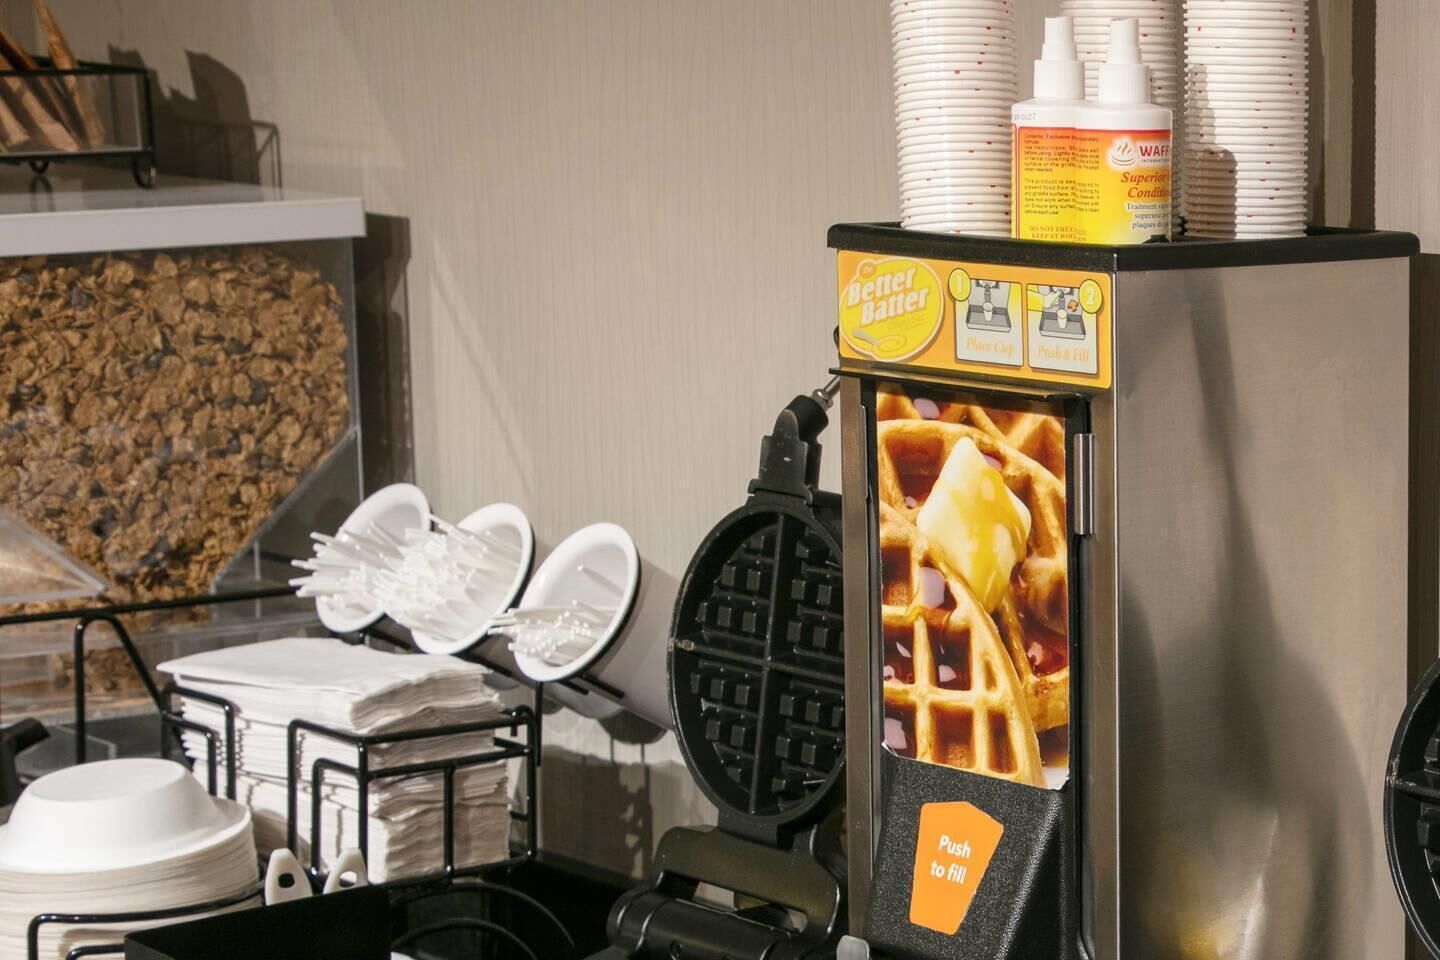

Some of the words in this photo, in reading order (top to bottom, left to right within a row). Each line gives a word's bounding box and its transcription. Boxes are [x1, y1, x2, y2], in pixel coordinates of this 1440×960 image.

[846, 267, 917, 308] Better
[860, 287, 929, 327] Batter
[937, 834, 971, 859] Push
[930, 860, 945, 878] to
[947, 863, 968, 885] fill
